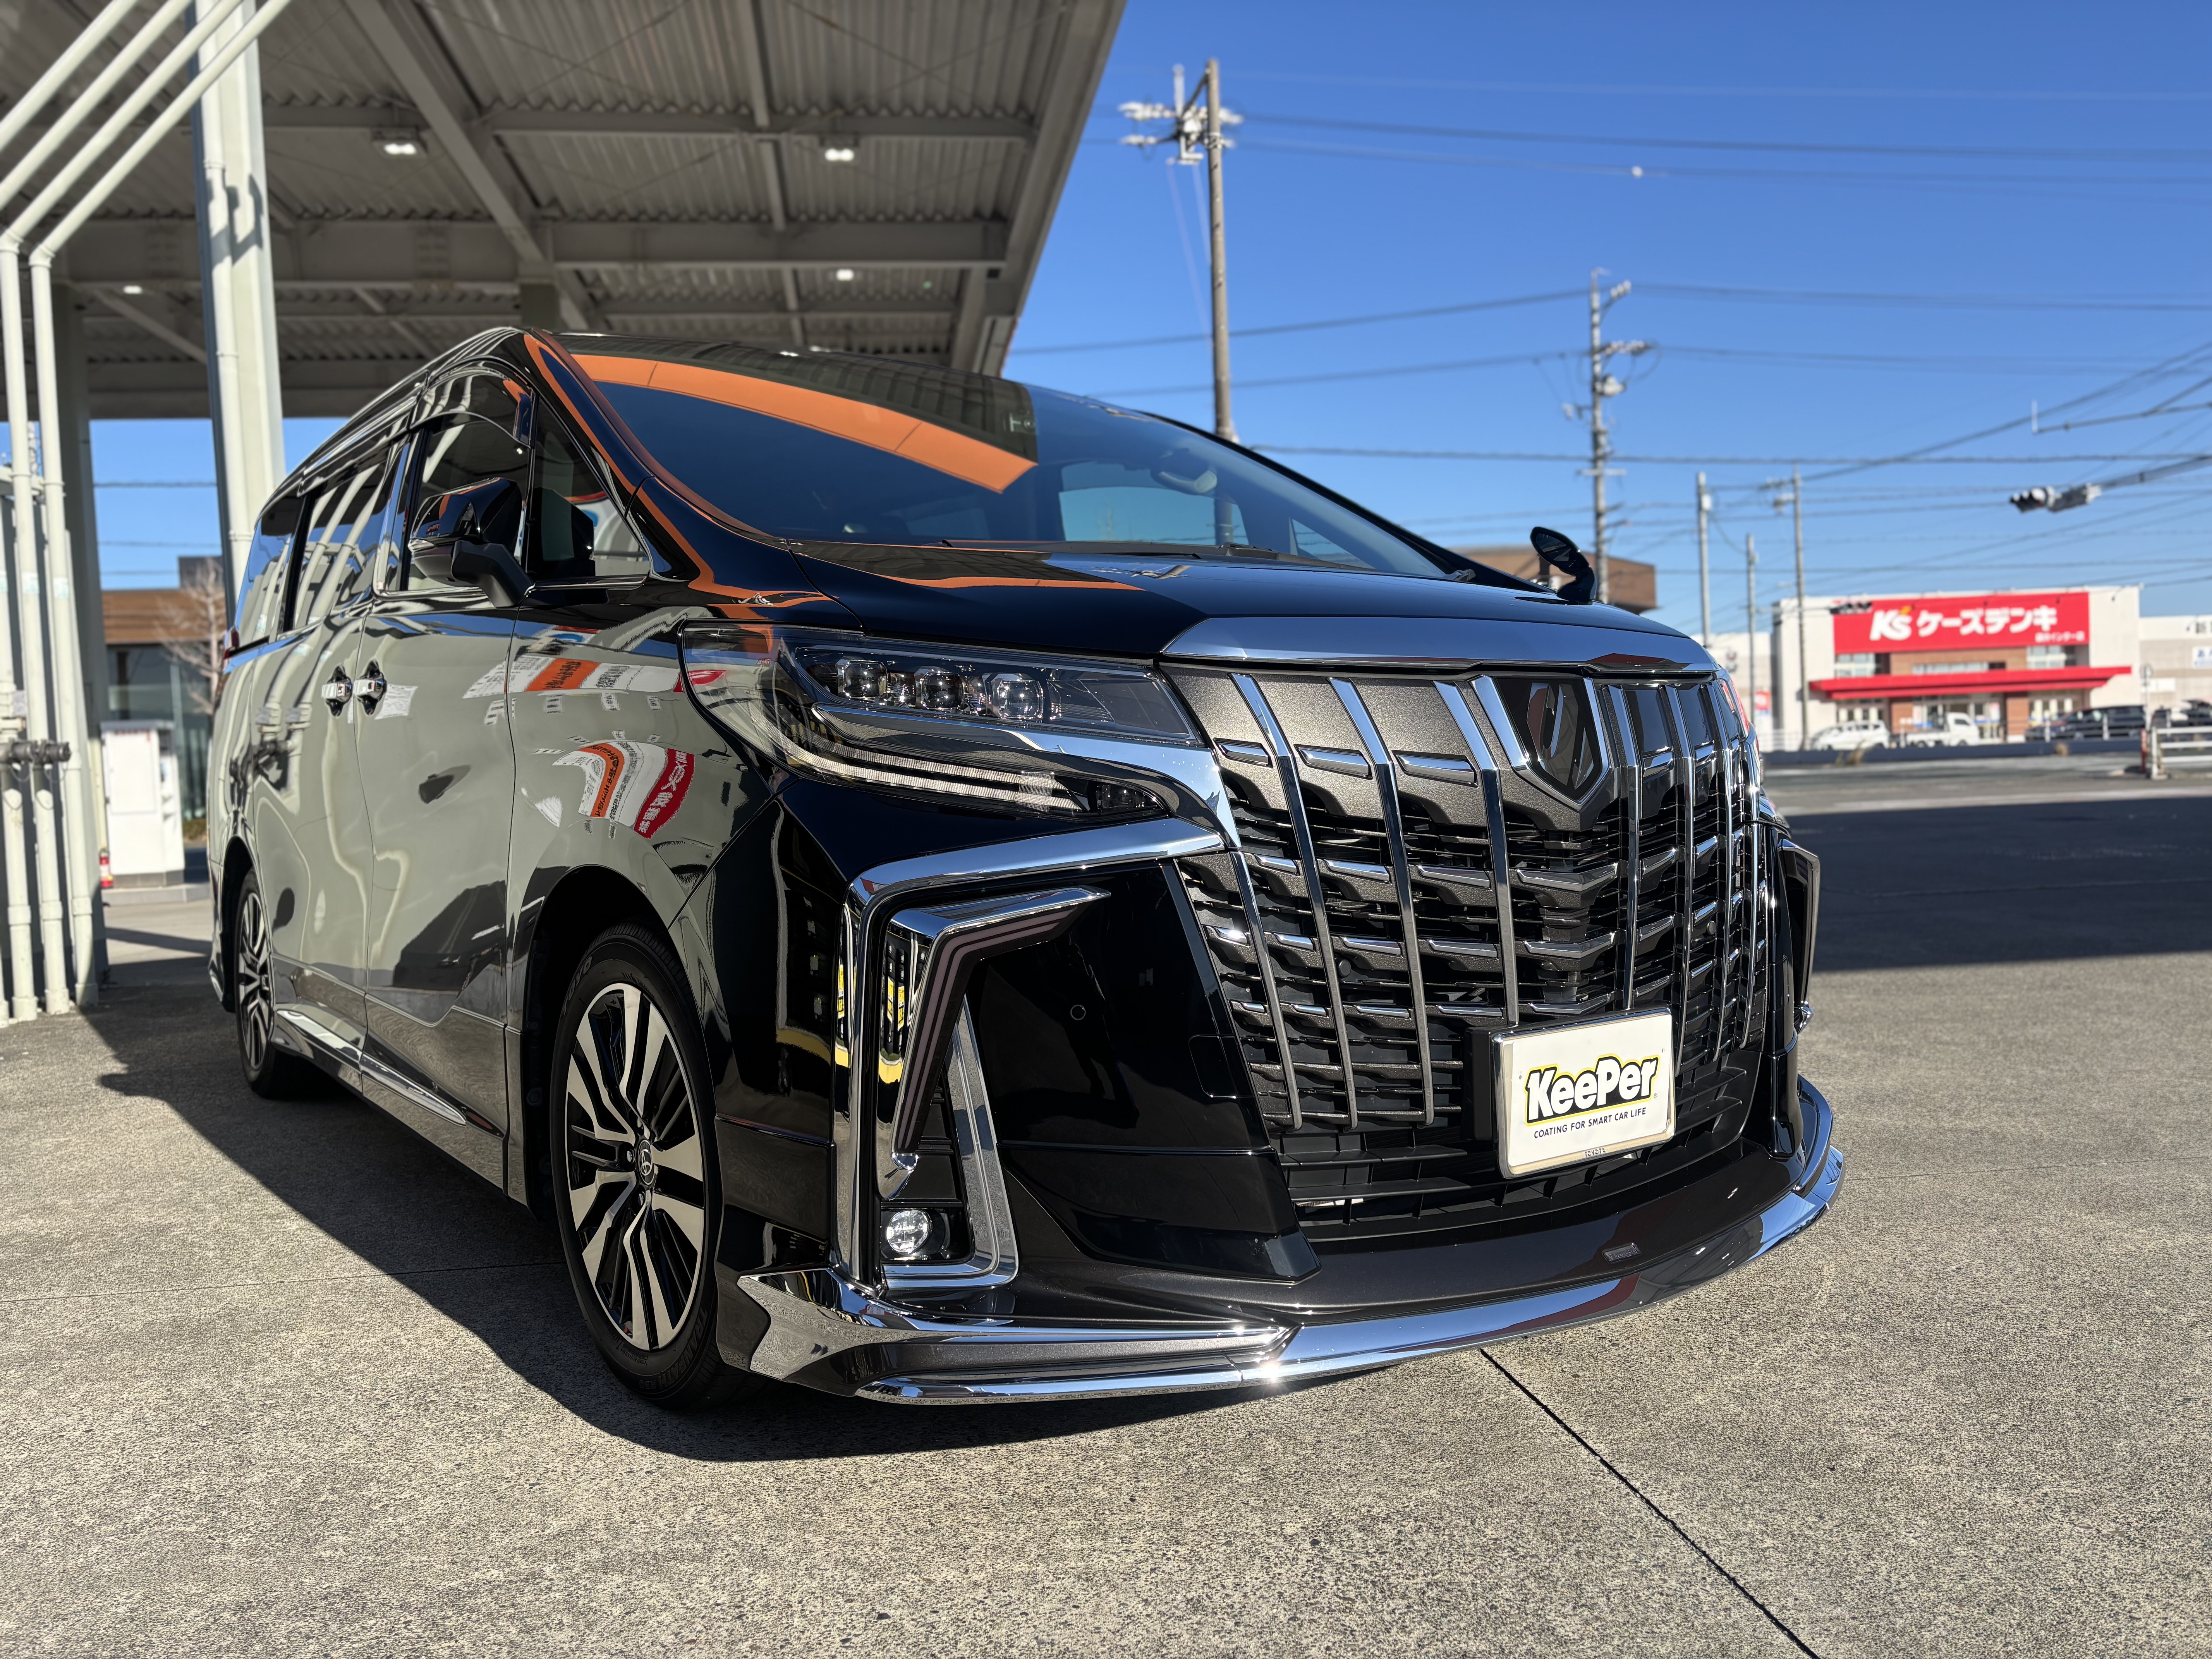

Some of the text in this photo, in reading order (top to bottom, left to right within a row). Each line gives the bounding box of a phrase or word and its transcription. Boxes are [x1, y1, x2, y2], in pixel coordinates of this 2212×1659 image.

[1870, 605, 2057, 640] K's ケーズデンキ
[1525, 1056, 1659, 1123] KeePer
[1534, 1107, 1646, 1139] COATING FOR SMART CAR LIFE
[1585, 1147, 1606, 1157] TOYOTA
